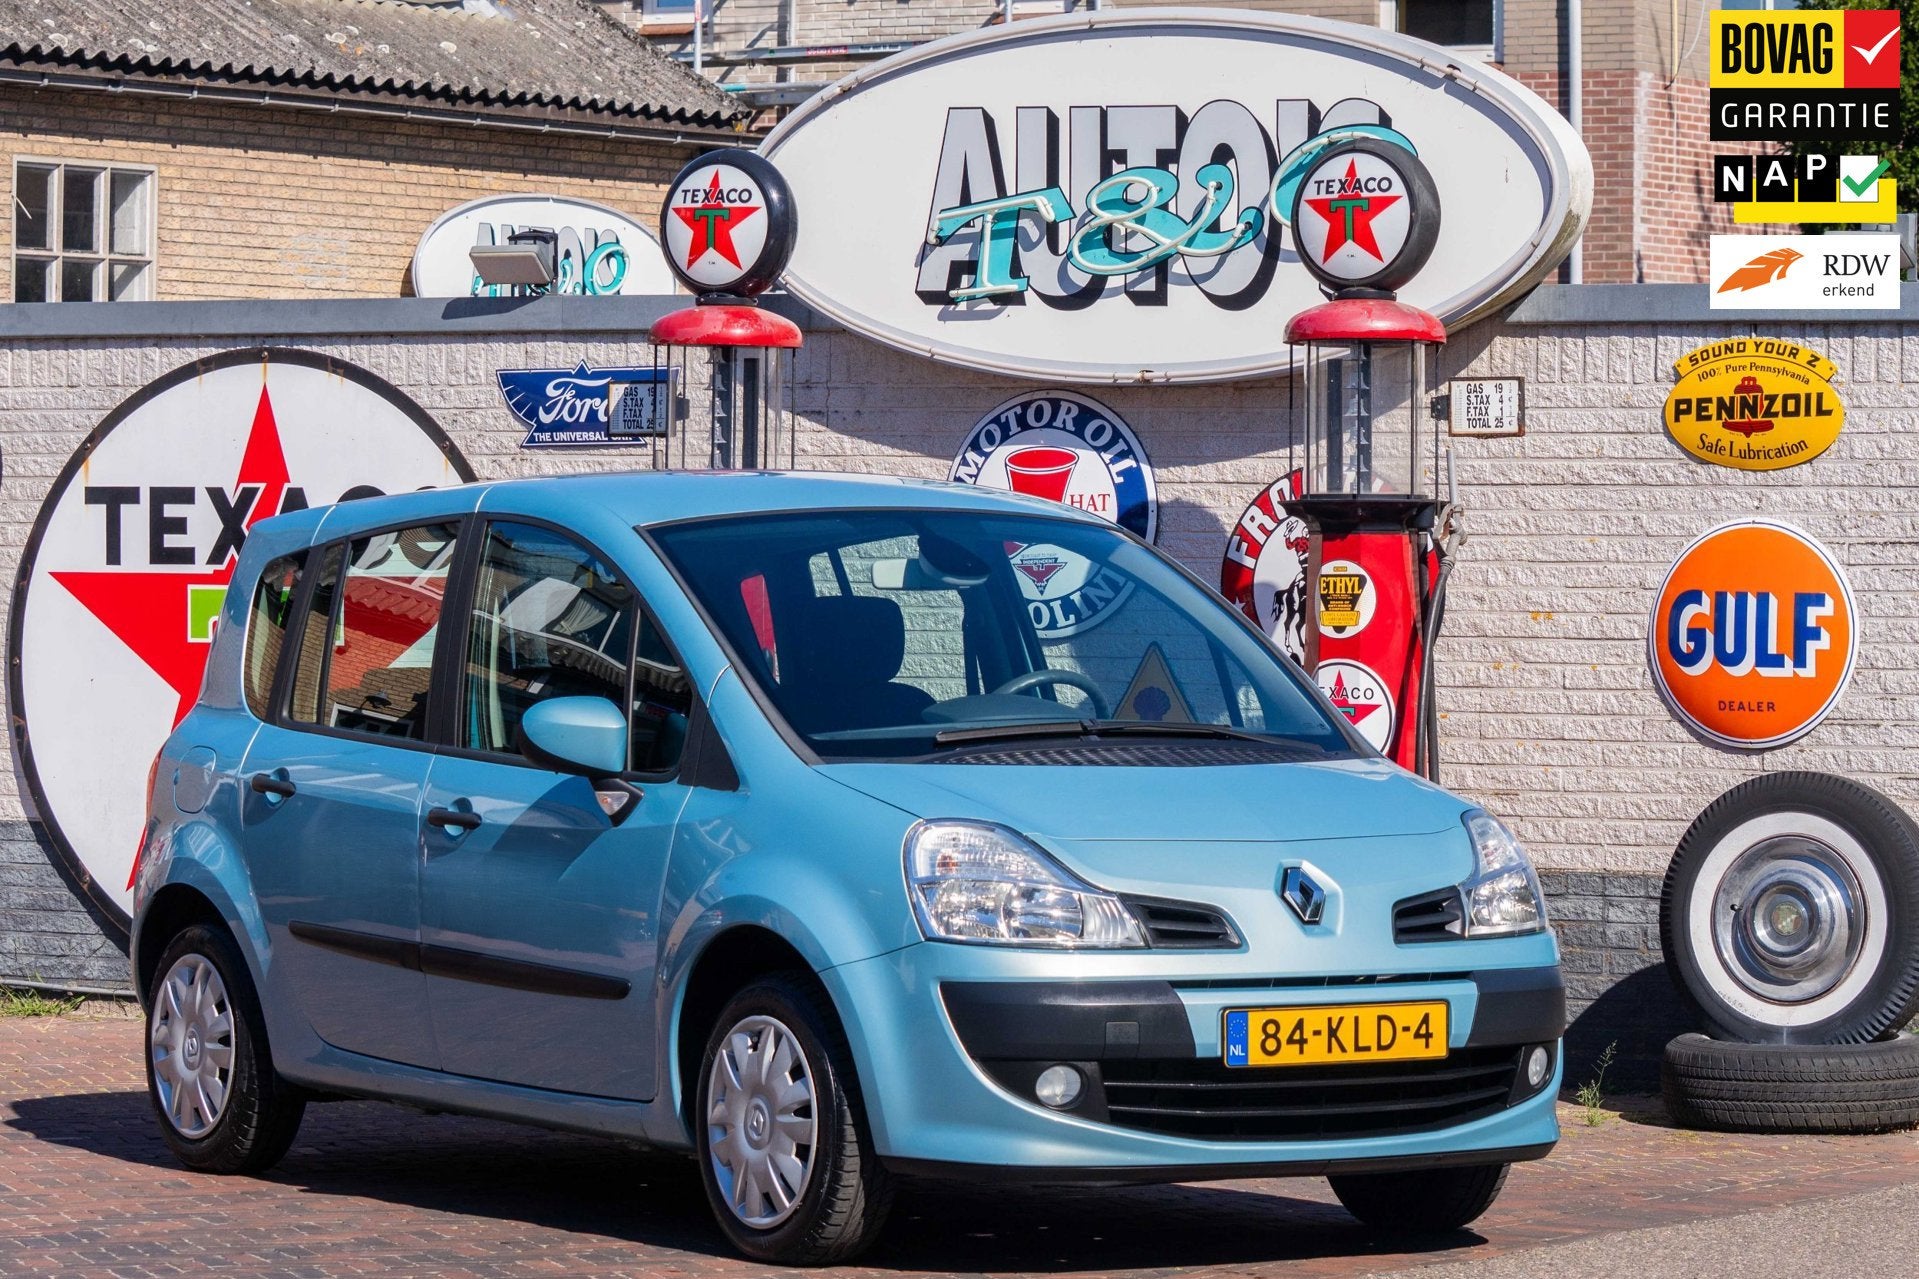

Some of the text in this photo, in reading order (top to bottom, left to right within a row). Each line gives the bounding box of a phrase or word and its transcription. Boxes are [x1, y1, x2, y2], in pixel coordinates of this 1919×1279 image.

[1314, 176, 1393, 196] TEXACO
[681, 188, 753, 204] TEXACO
[1329, 198, 1370, 242] T
[694, 208, 730, 249] T
[1689, 341, 1821, 368] SOUND YOUR Z
[1697, 362, 1810, 385] 100% Pure Pennsylvania
[623, 386, 639, 397] GAS
[1466, 383, 1483, 394] GAS
[1494, 383, 1503, 394] 19
[623, 397, 644, 408] S.TAX
[1466, 395, 1490, 406] S.TAX
[1498, 394, 1504, 405] 4
[1674, 392, 1834, 423] PENNZOIL
[622, 408, 643, 419] F.TAX
[1466, 406, 1489, 417] F.TAX
[1500, 406, 1504, 417] 1
[622, 419, 644, 430] TOTAL
[1466, 418, 1491, 429] TOTAL
[1494, 418, 1504, 429] 25
[534, 432, 551, 442] THE
[553, 431, 608, 442] UNIVERSAL
[956, 400, 1140, 485] MOTOR OIL
[1697, 433, 1809, 460] Safe Lubrication
[1069, 494, 1111, 511] HAT
[1320, 577, 1362, 594] ETHYL
[1668, 589, 1835, 678] GULF
[1319, 687, 1375, 701] XACO
[1718, 701, 1776, 713] DEALER
[1230, 1012, 1434, 1057] NL 84-KLD-4
